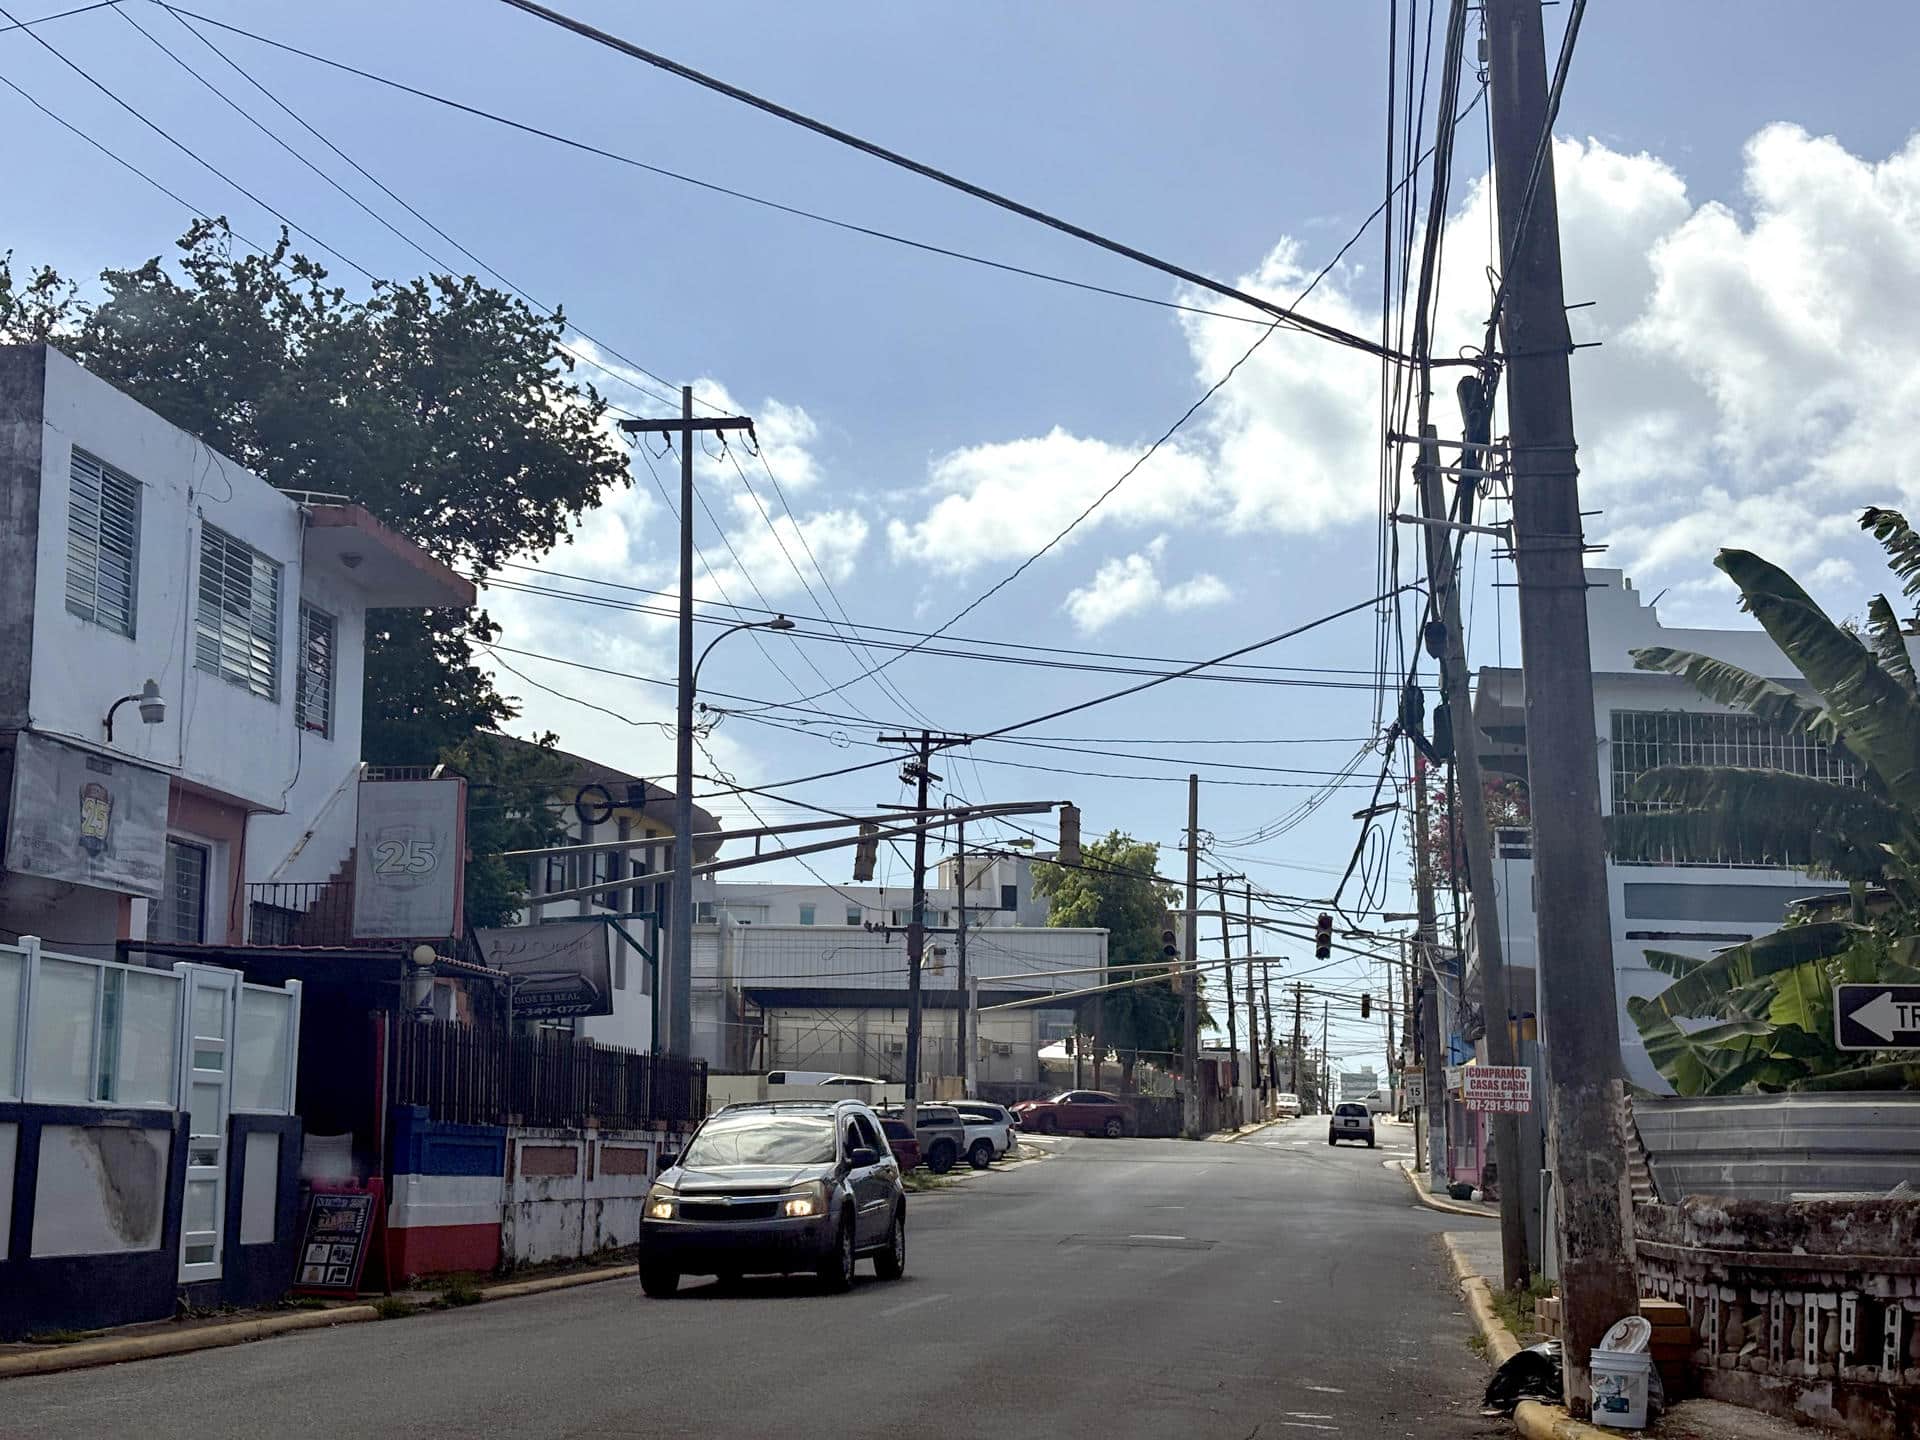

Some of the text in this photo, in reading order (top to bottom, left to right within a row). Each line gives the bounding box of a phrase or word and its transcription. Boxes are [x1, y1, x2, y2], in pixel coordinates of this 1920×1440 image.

[81, 797, 110, 840] 25
[374, 840, 437, 875] 25
[1896, 1005, 1920, 1029] TR
[1410, 1087, 1421, 1096] 15
[1470, 1079, 1530, 1092] CASAS CASH!
